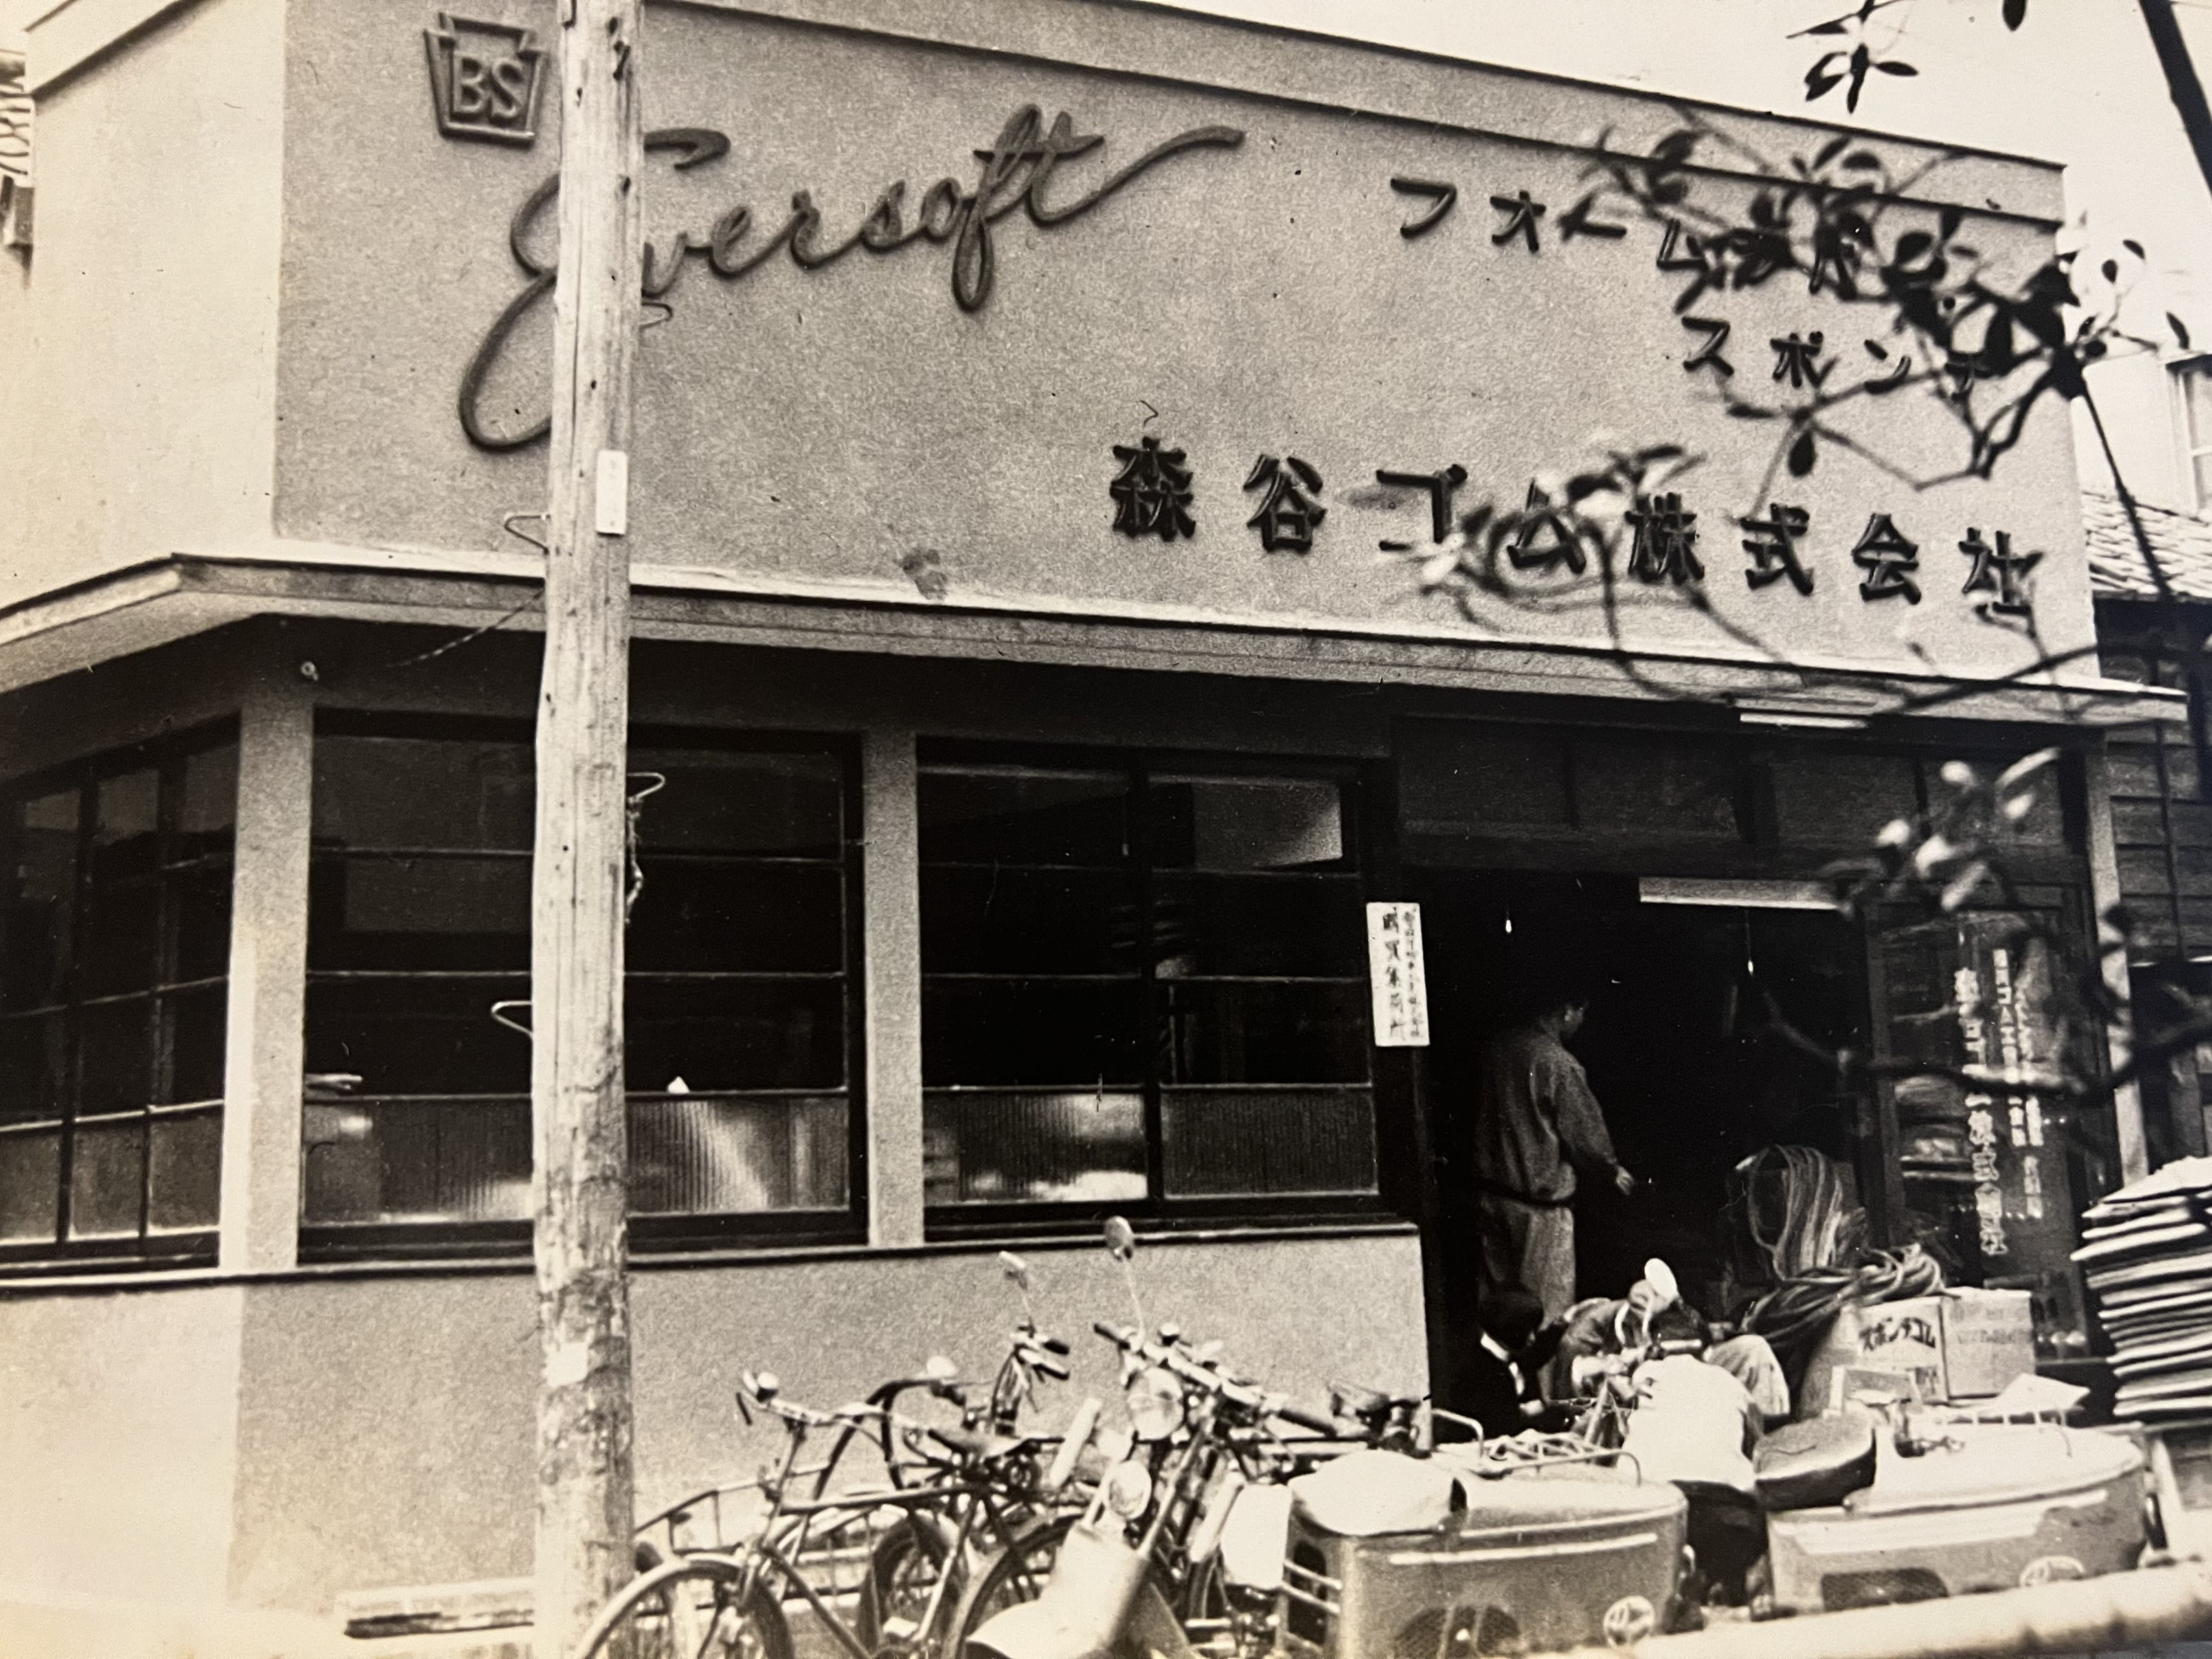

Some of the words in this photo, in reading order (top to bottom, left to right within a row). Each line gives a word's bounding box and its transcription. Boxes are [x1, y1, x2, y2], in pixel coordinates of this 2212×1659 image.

[451, 52, 528, 120] BS
[459, 103, 1246, 452] Eversoft
[1110, 437, 2035, 616] 森谷ゴム株式会社
